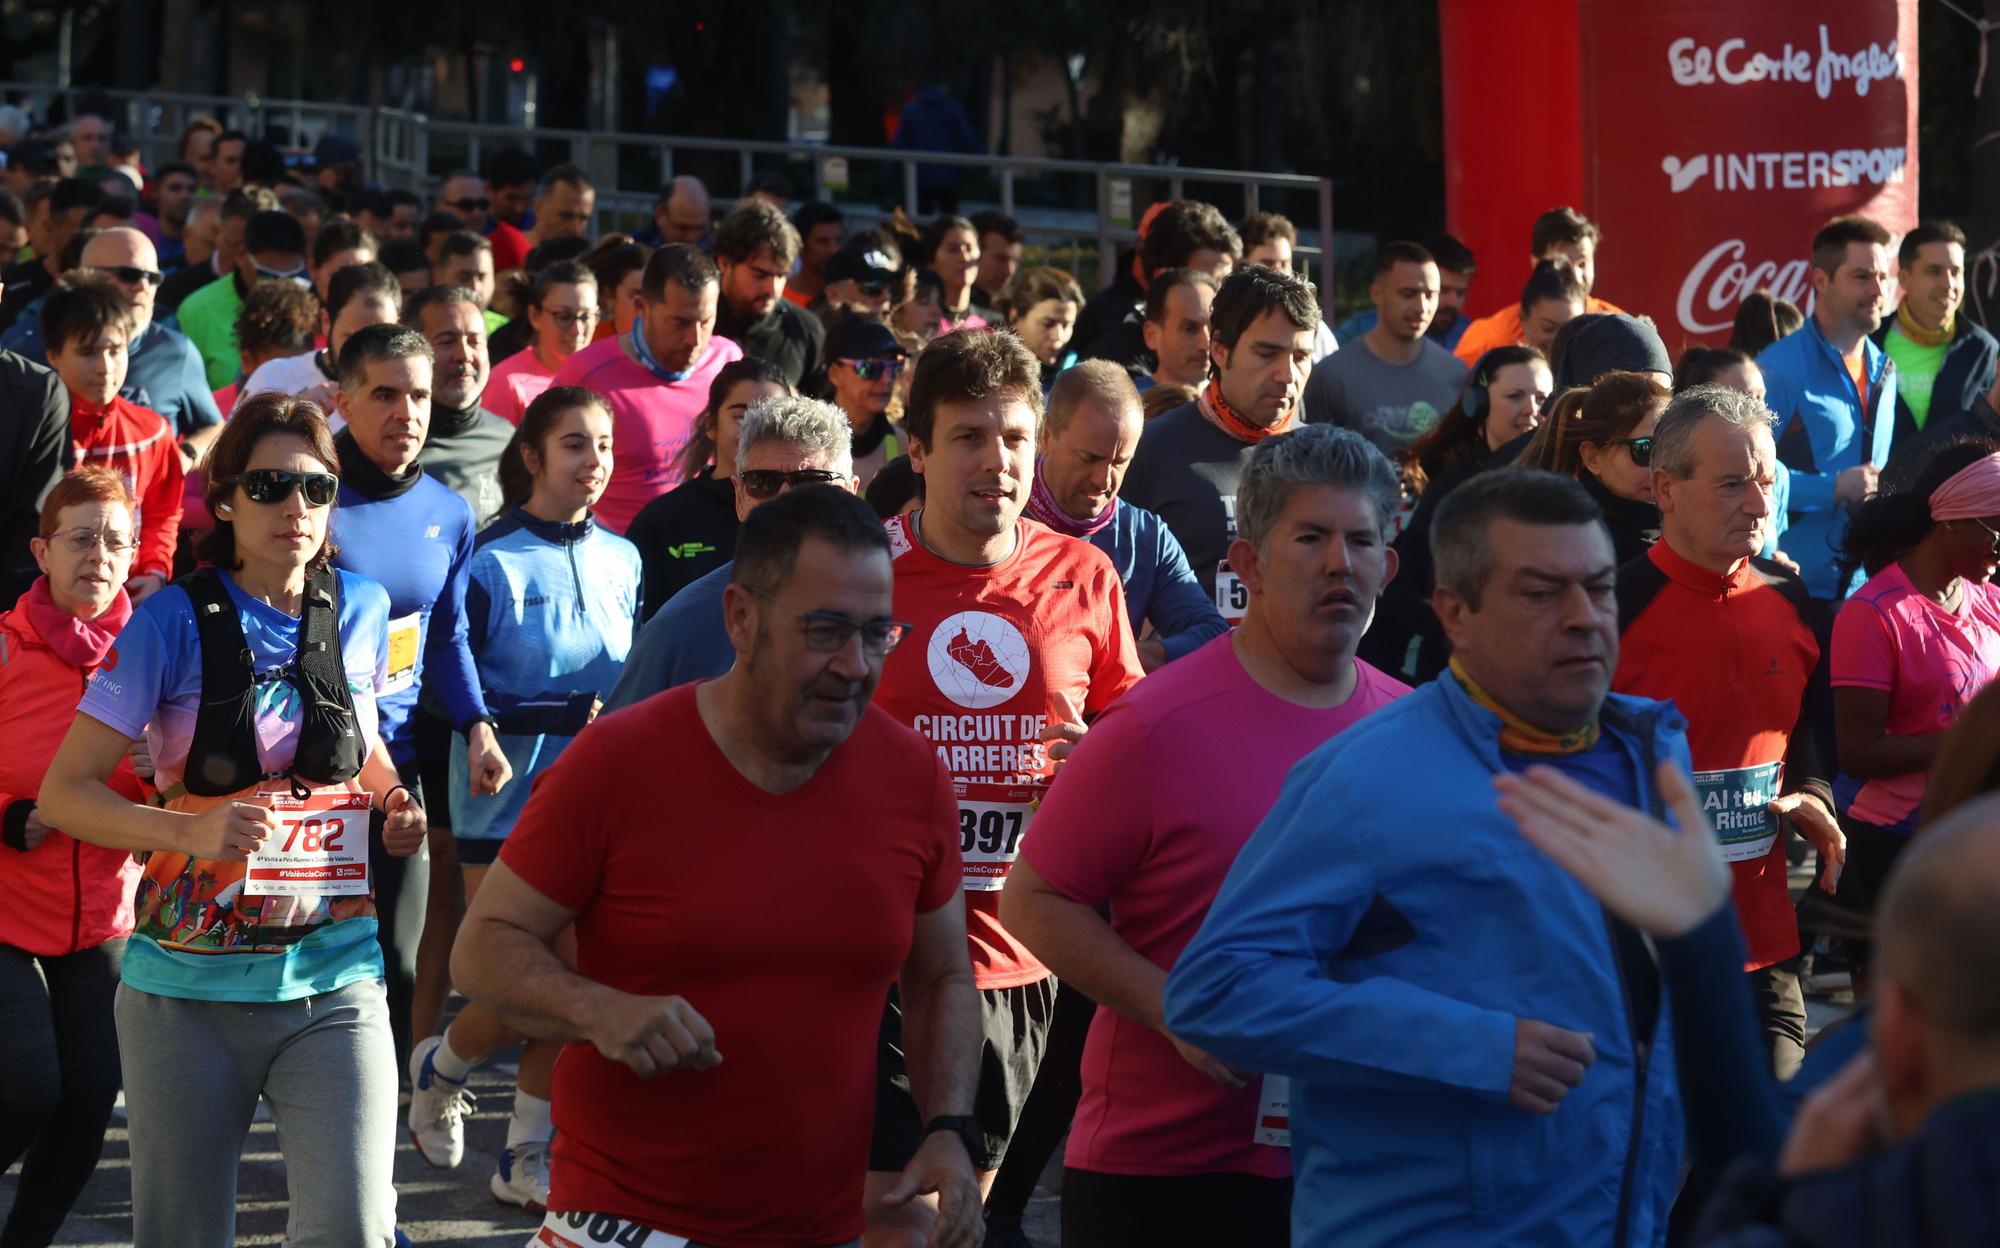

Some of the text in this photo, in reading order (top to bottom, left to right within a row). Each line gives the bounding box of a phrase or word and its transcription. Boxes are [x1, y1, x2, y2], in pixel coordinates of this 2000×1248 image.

[1668, 37, 1715, 86] El
[1716, 38, 1812, 85] Corte
[914, 715, 1016, 742] CIRCUIT
[936, 744, 1046, 772] ARRERES
[1703, 789, 1728, 810] Al
[1716, 810, 1765, 831] Ritme
[281, 818, 344, 852] 782
[963, 865, 1004, 874] nciaCorre
